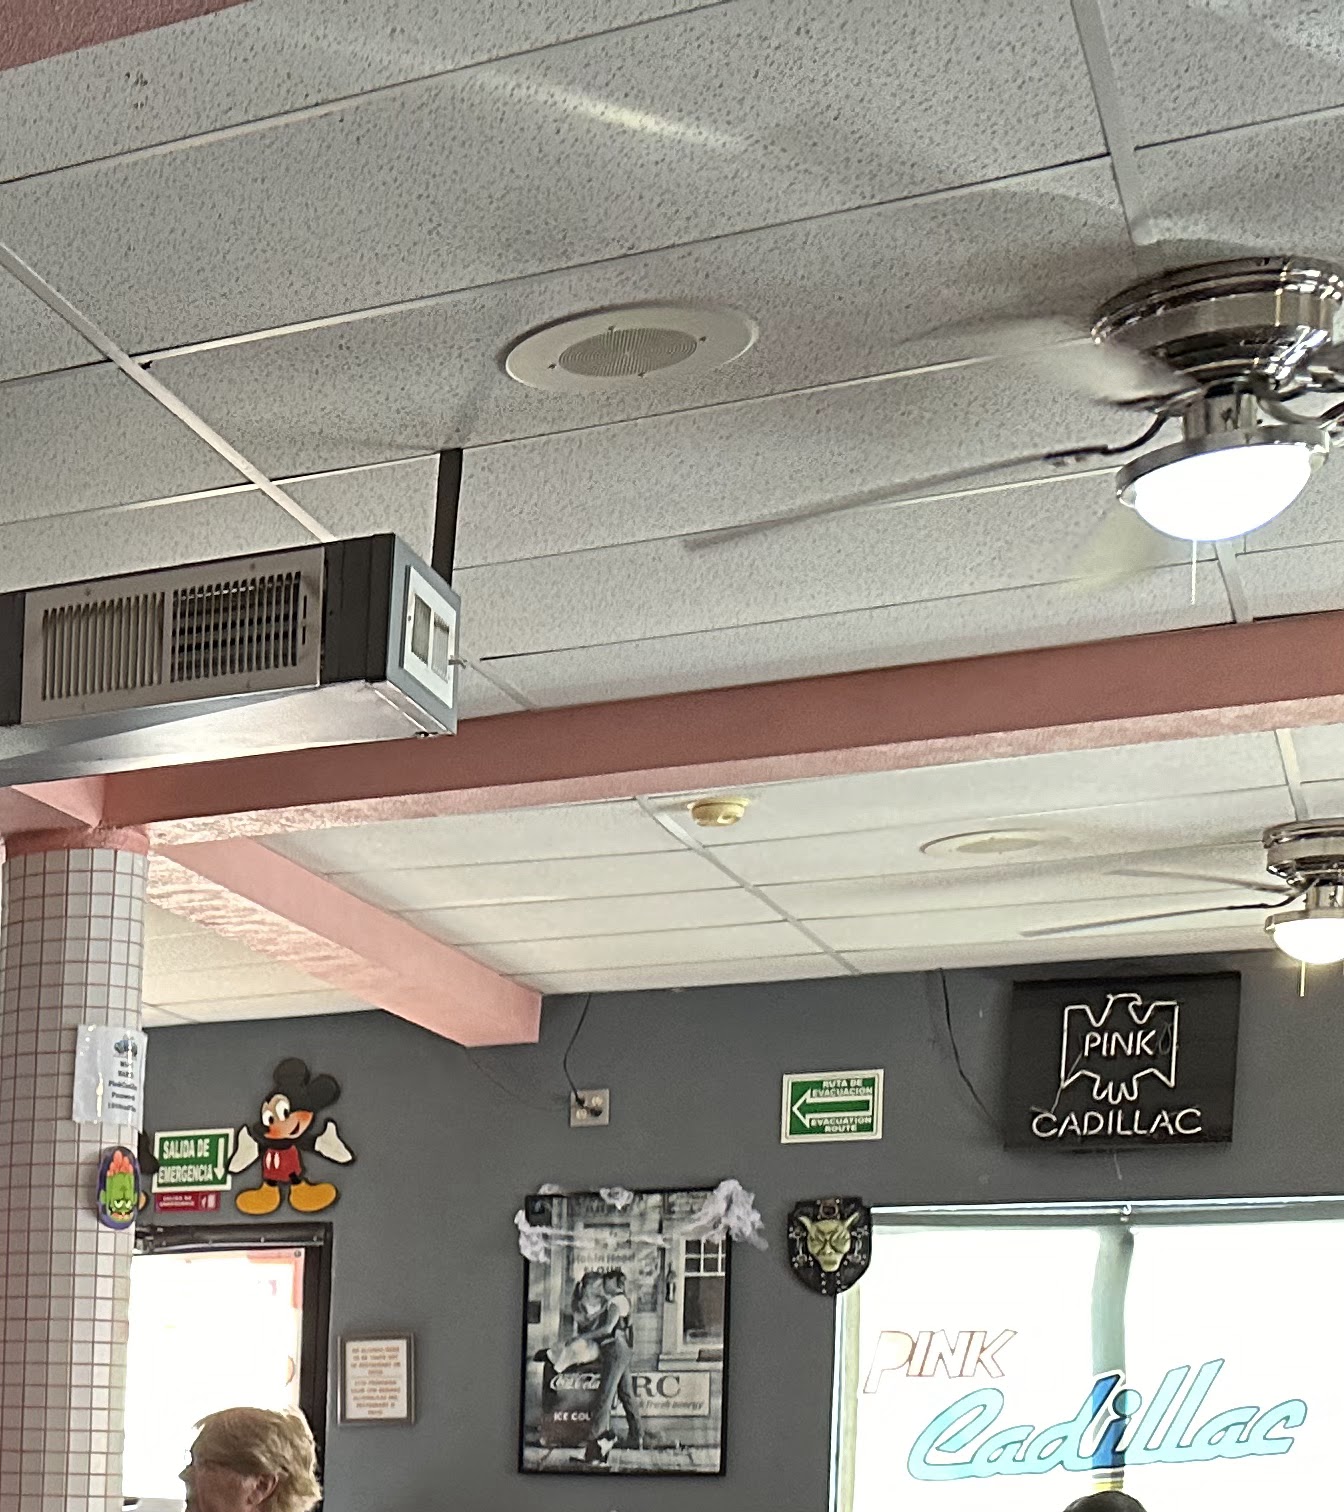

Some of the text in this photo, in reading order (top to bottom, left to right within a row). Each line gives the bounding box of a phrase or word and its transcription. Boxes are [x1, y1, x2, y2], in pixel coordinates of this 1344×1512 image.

[1083, 1029, 1157, 1057] PINK
[822, 1078, 863, 1089] RUTA DE
[810, 1116, 872, 1127] EVACUATION
[824, 1124, 858, 1133] ROUTE
[1031, 1107, 1202, 1138] CADILLAC
[162, 1138, 210, 1159] SALIDA DE
[158, 1164, 214, 1184] EMERGENCIA
[862, 1328, 1018, 1395] PINK
[631, 1374, 681, 1399] RC
[570, 1411, 593, 1421] COL
[906, 1357, 1309, 1482] Cadillac
